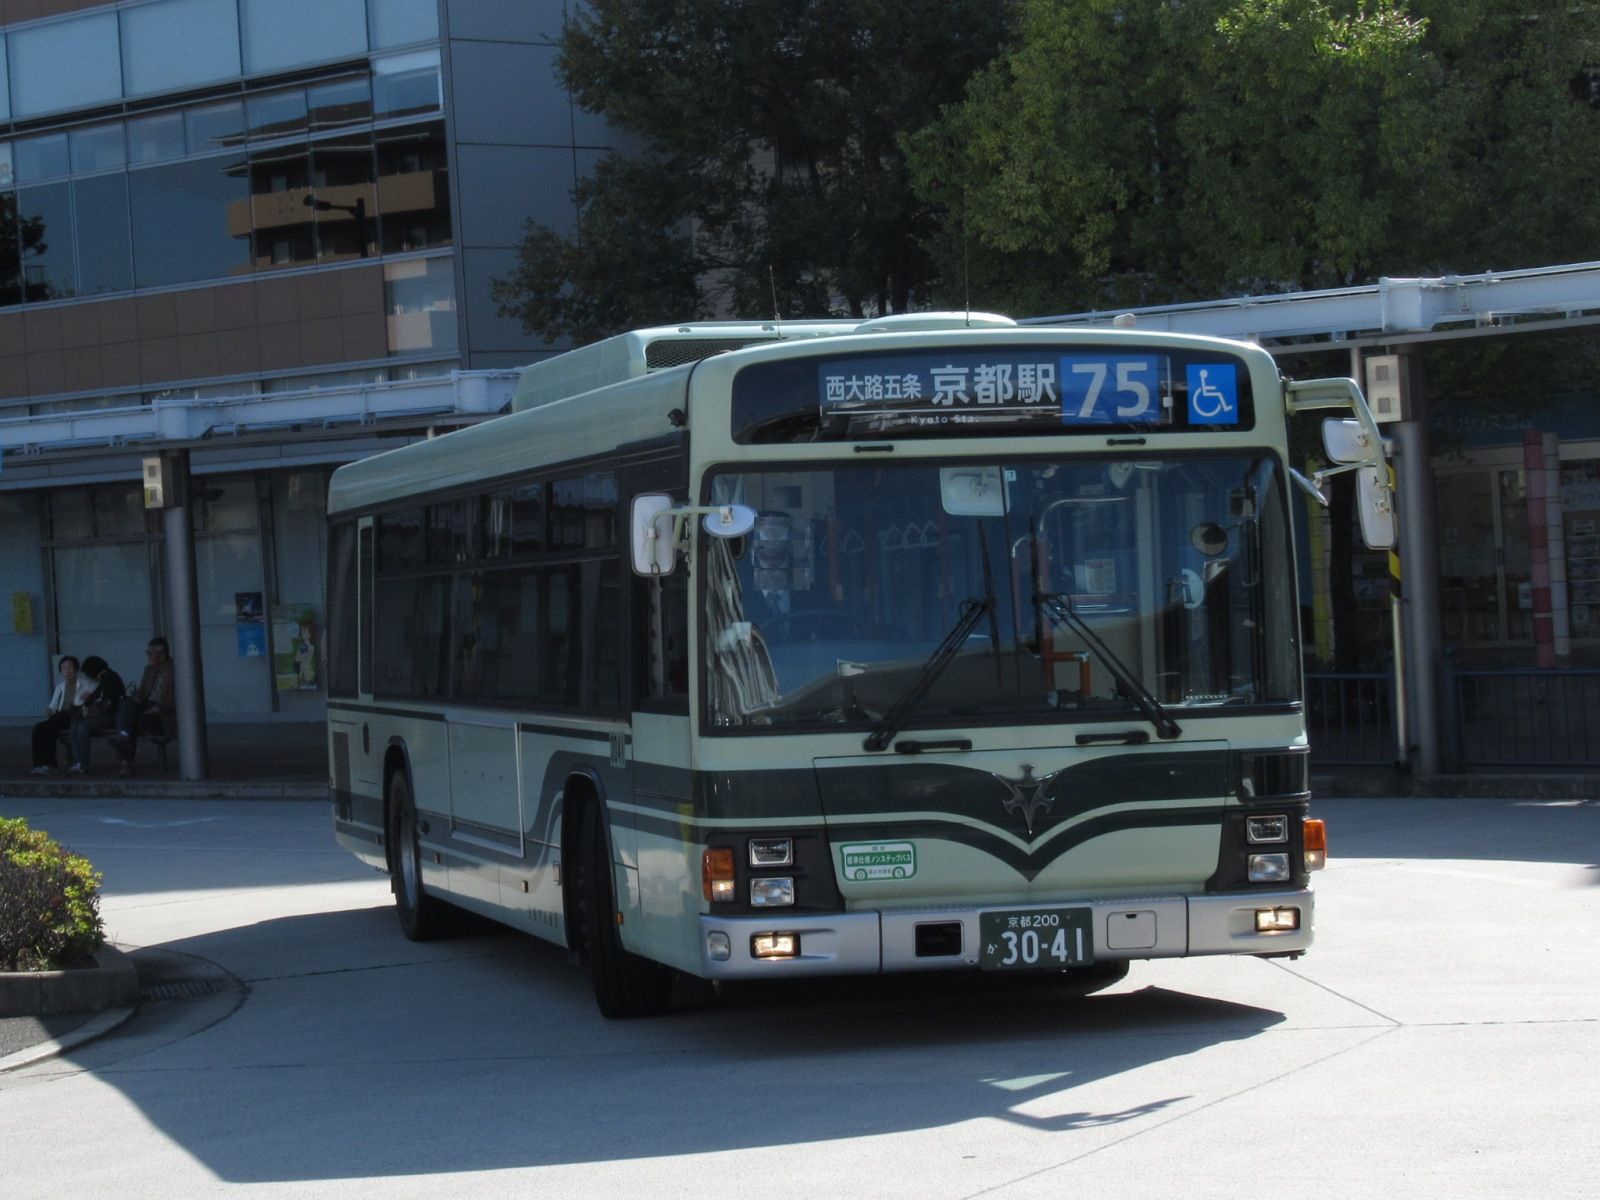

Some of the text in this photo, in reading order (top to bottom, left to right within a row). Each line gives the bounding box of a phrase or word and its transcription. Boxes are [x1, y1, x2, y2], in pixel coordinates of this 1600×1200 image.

[825, 363, 1057, 405] 西大路五条 京都駅
[1071, 360, 1151, 420] 75
[910, 414, 979, 427] Kyoto Sta.
[1000, 927, 1084, 966] 30-41
